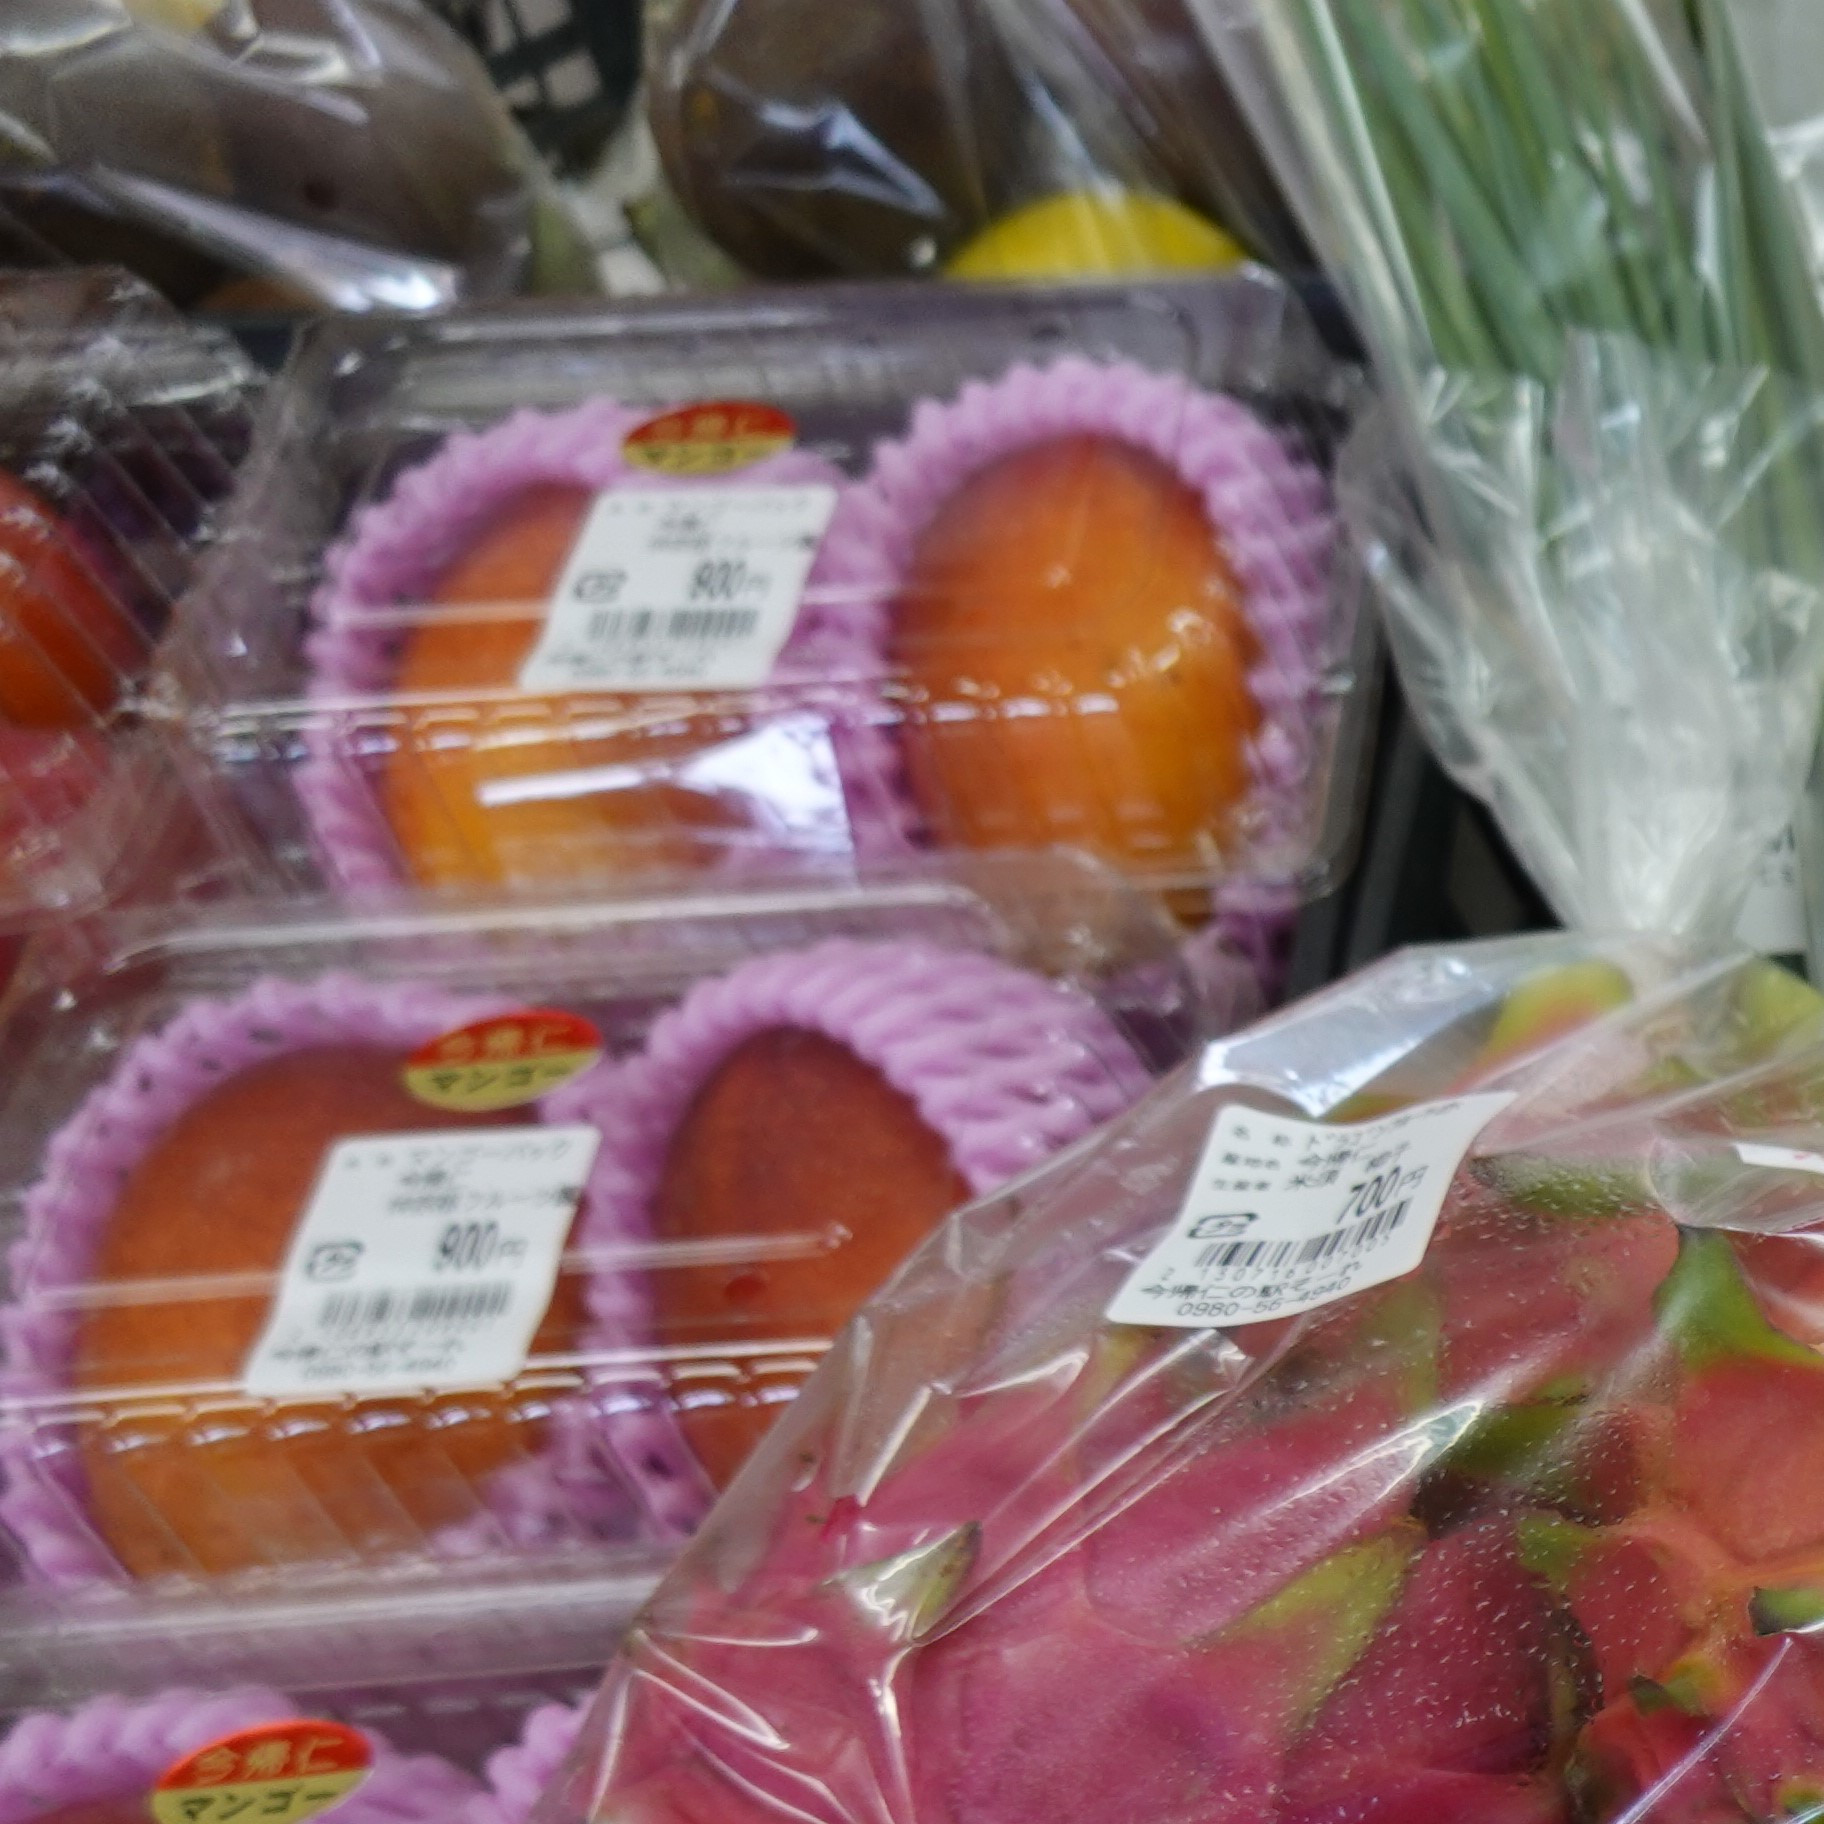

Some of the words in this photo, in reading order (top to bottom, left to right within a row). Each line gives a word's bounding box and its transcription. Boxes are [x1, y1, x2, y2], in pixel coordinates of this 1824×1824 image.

[1336, 1164, 1430, 1225] 700円
[194, 1734, 347, 1786] 今帰仁
[182, 1790, 341, 1823] マンゴー
